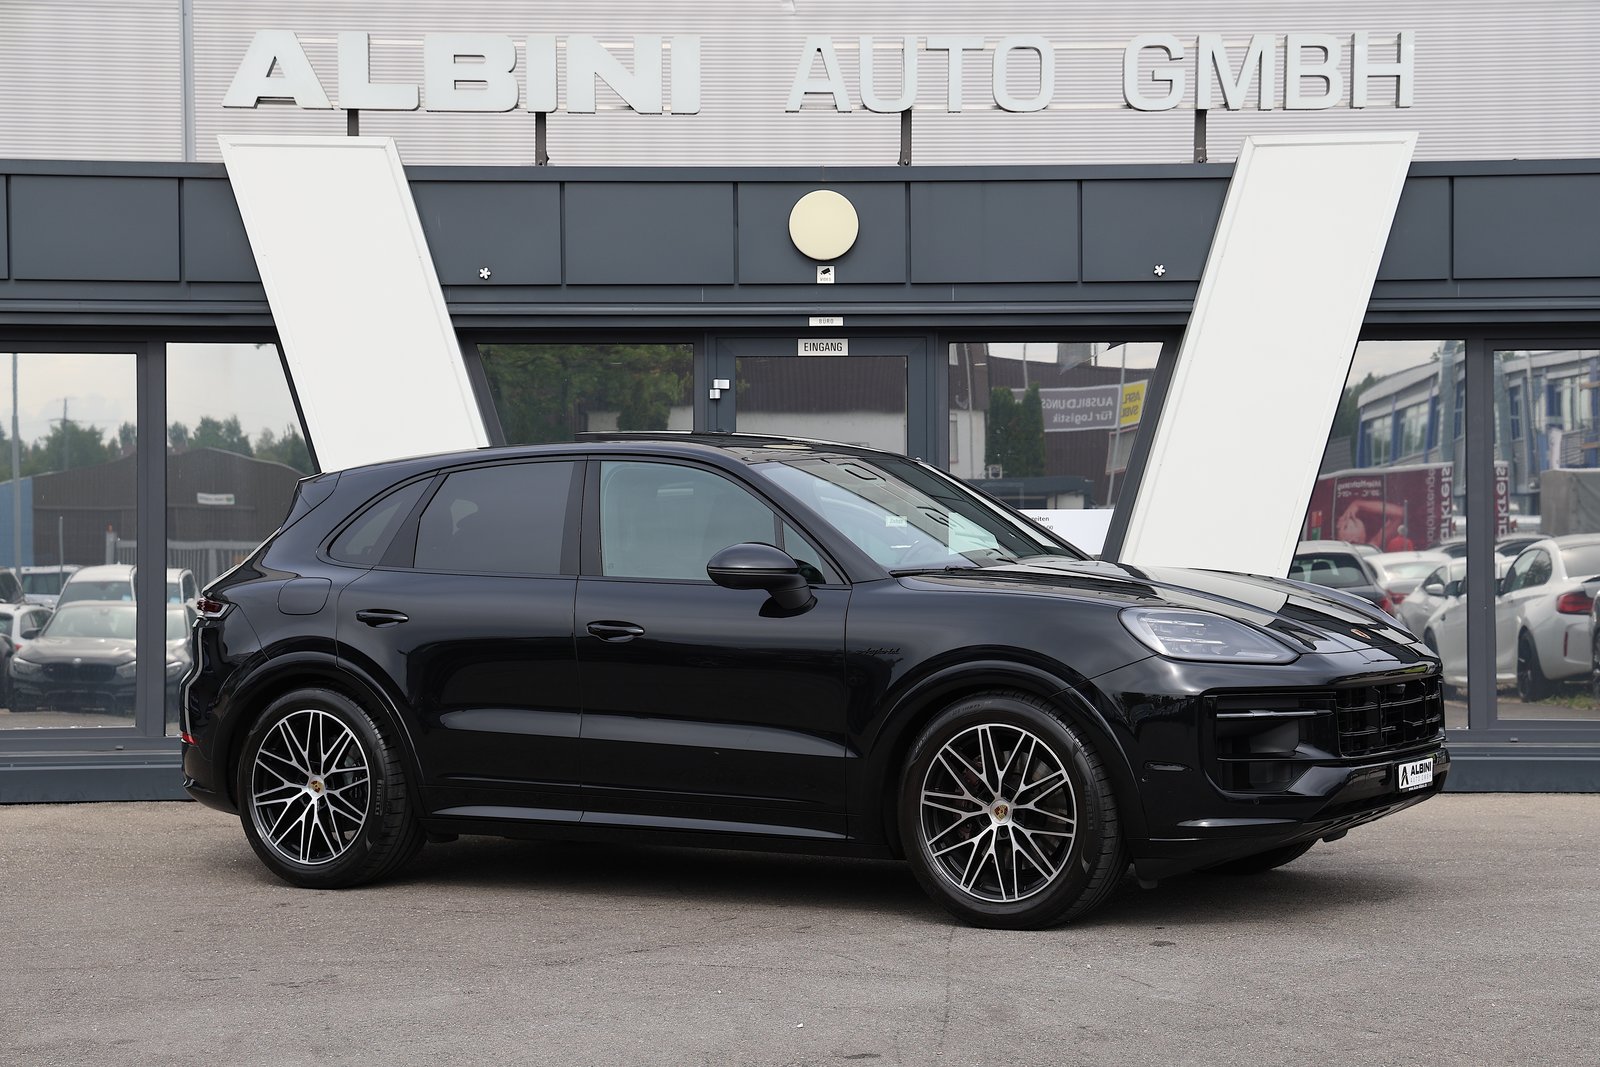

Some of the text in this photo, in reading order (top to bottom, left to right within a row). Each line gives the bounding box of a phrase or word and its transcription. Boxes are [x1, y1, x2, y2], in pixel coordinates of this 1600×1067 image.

[222, 29, 1415, 115] ALBINI AUTO GMBH
[804, 342, 843, 352] EINGANG
[1410, 761, 1432, 776] ALBINI
